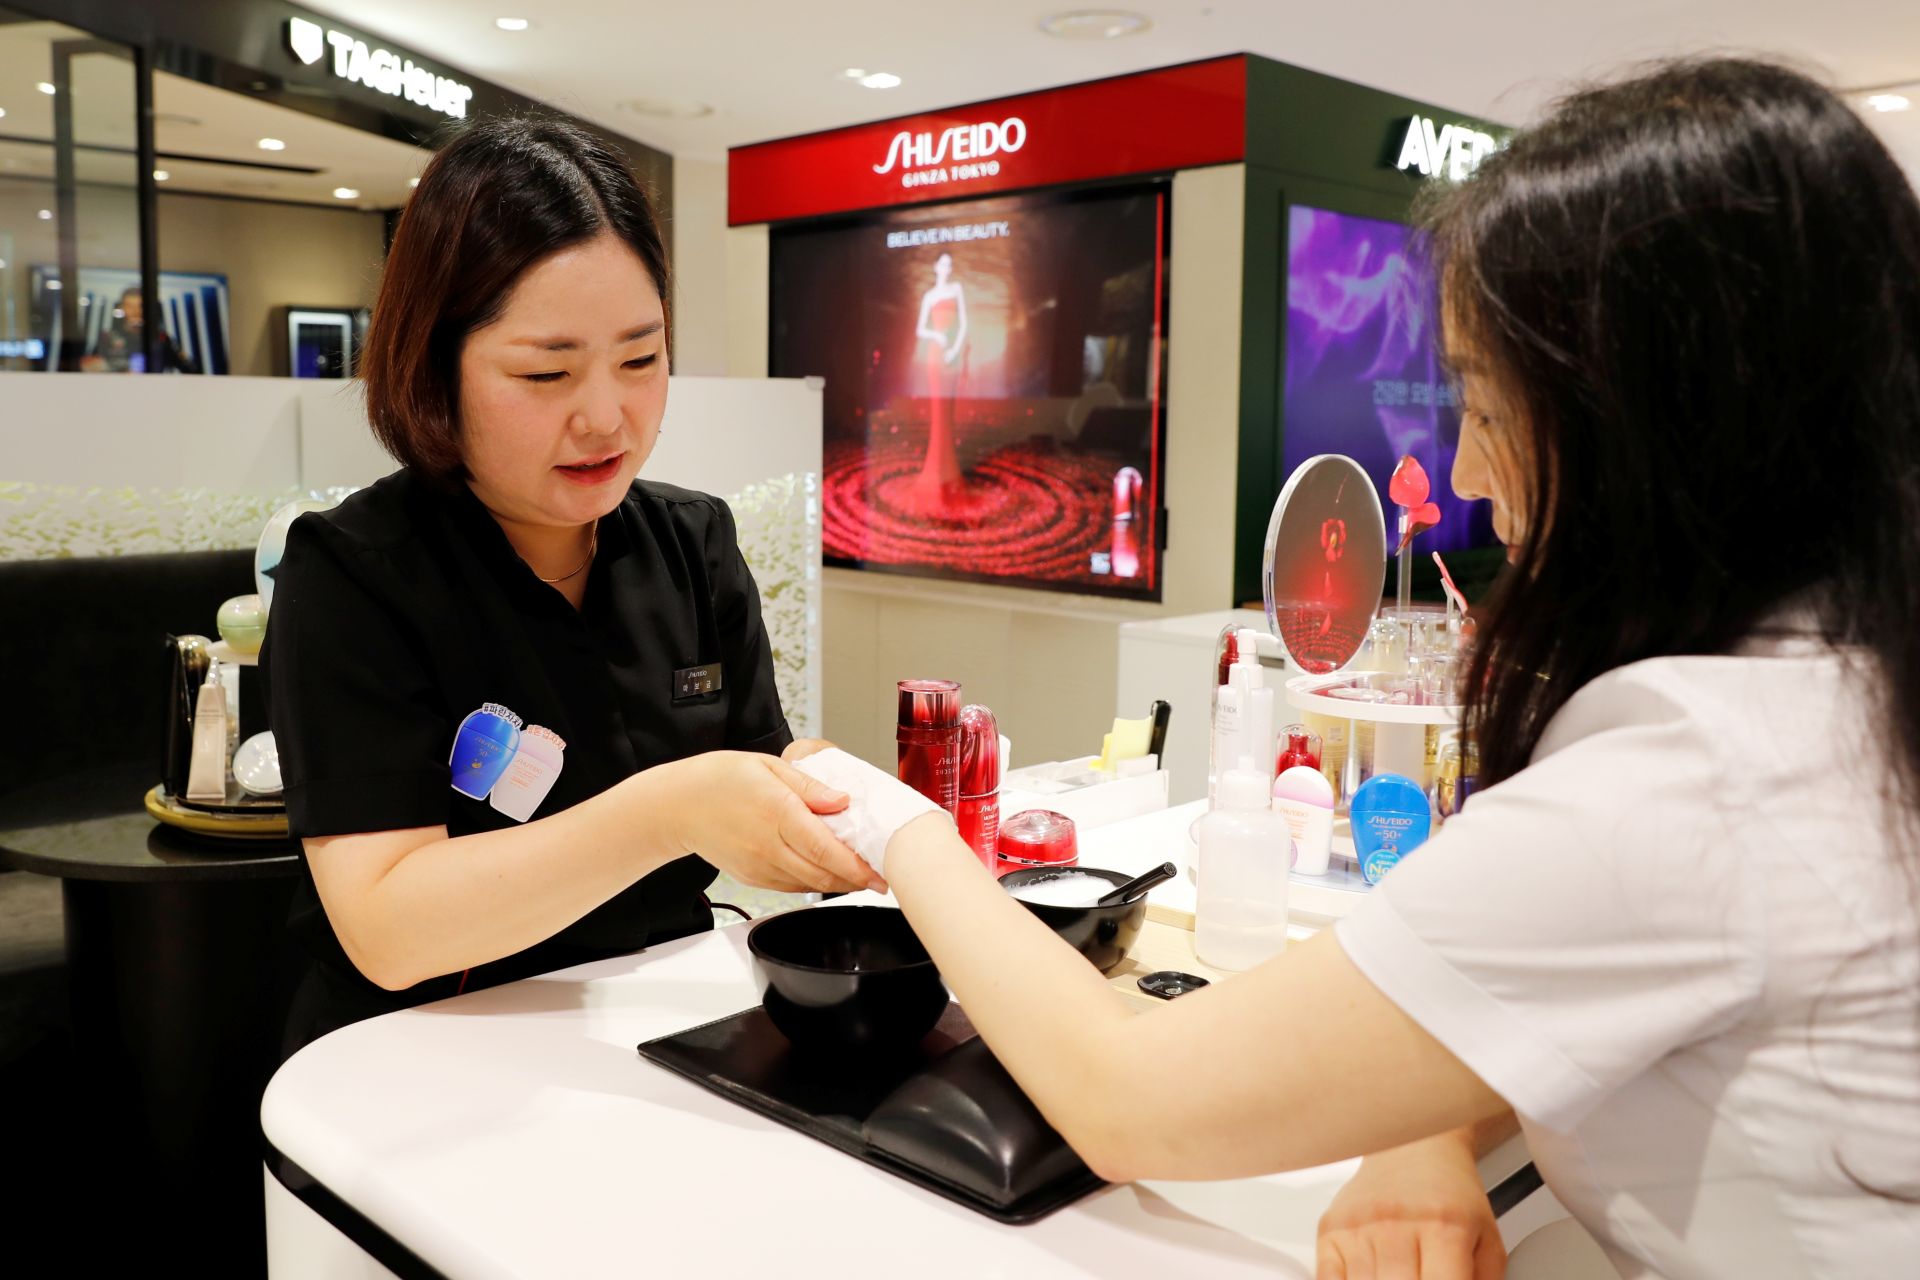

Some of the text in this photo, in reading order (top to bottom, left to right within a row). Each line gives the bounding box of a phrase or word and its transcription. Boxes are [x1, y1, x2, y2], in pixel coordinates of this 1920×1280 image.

[872, 117, 1026, 174] SHISEIDO
[1397, 114, 1497, 180] AVED
[902, 160, 1000, 188] GINZA TOKYO
[887, 228, 938, 248] BELIEVE
[940, 227, 953, 243] IN
[1367, 815, 1412, 826] SHISEIDO
